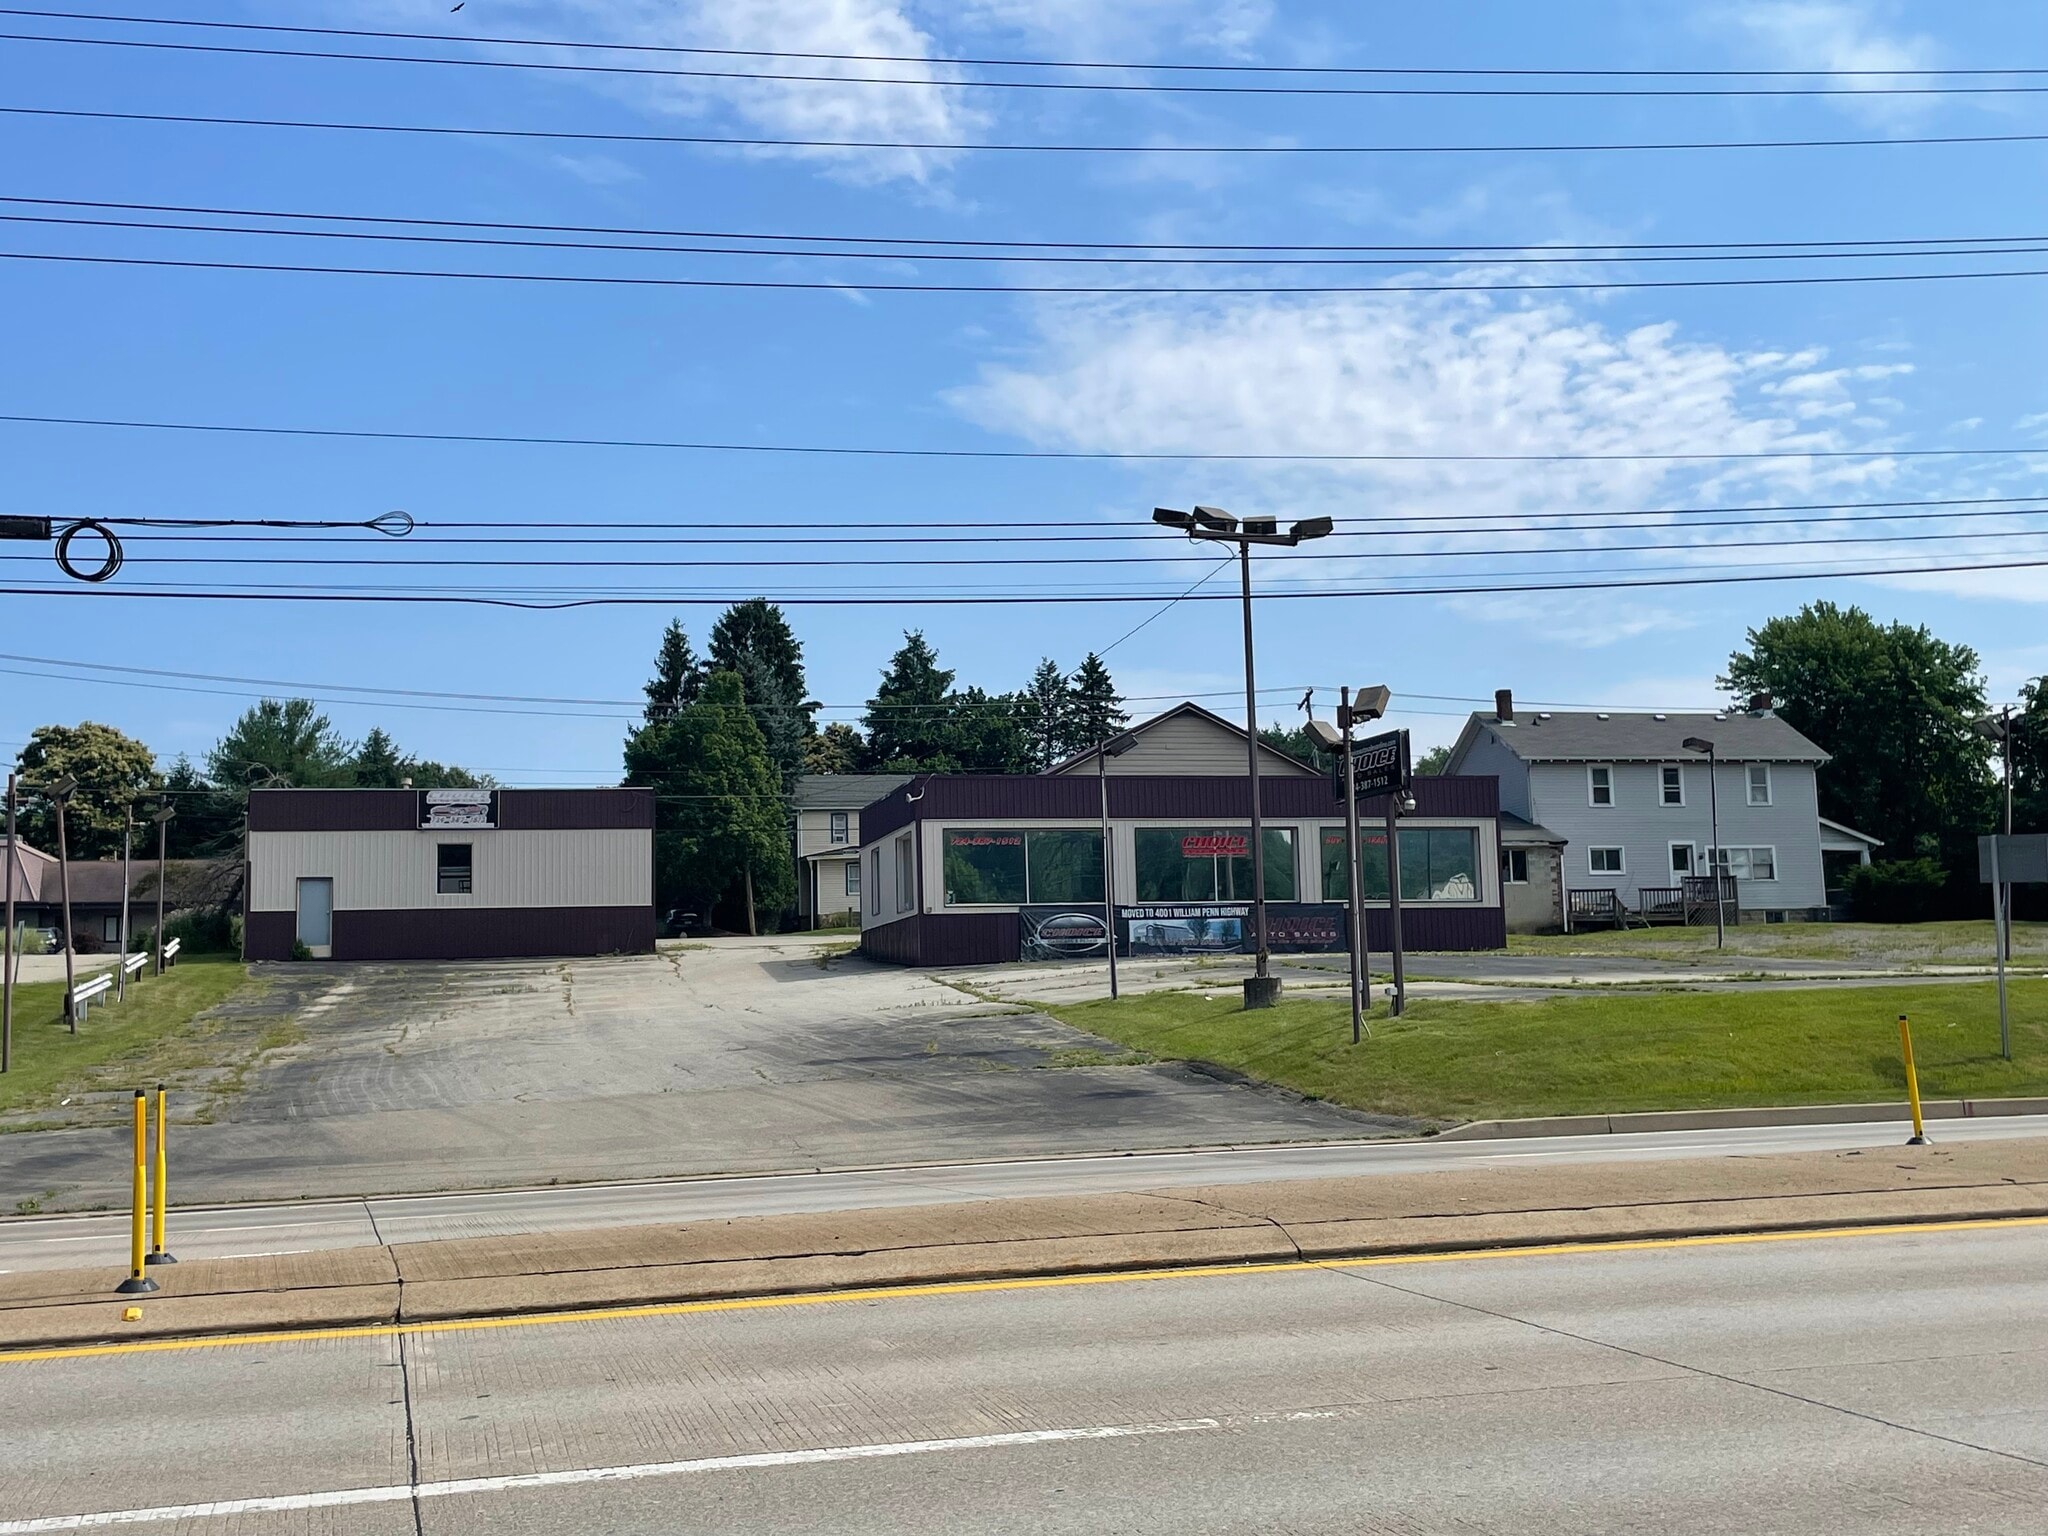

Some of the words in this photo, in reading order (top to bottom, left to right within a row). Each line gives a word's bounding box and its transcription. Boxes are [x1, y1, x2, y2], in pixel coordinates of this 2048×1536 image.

[1121, 908, 1145, 918] MOVED
[1145, 908, 1154, 918] TO
[1155, 908, 1172, 918] 4001
[1173, 908, 1201, 917] WILLIAM
[1202, 907, 1220, 917] PENN
[1220, 907, 1249, 917] HIGHWAY
